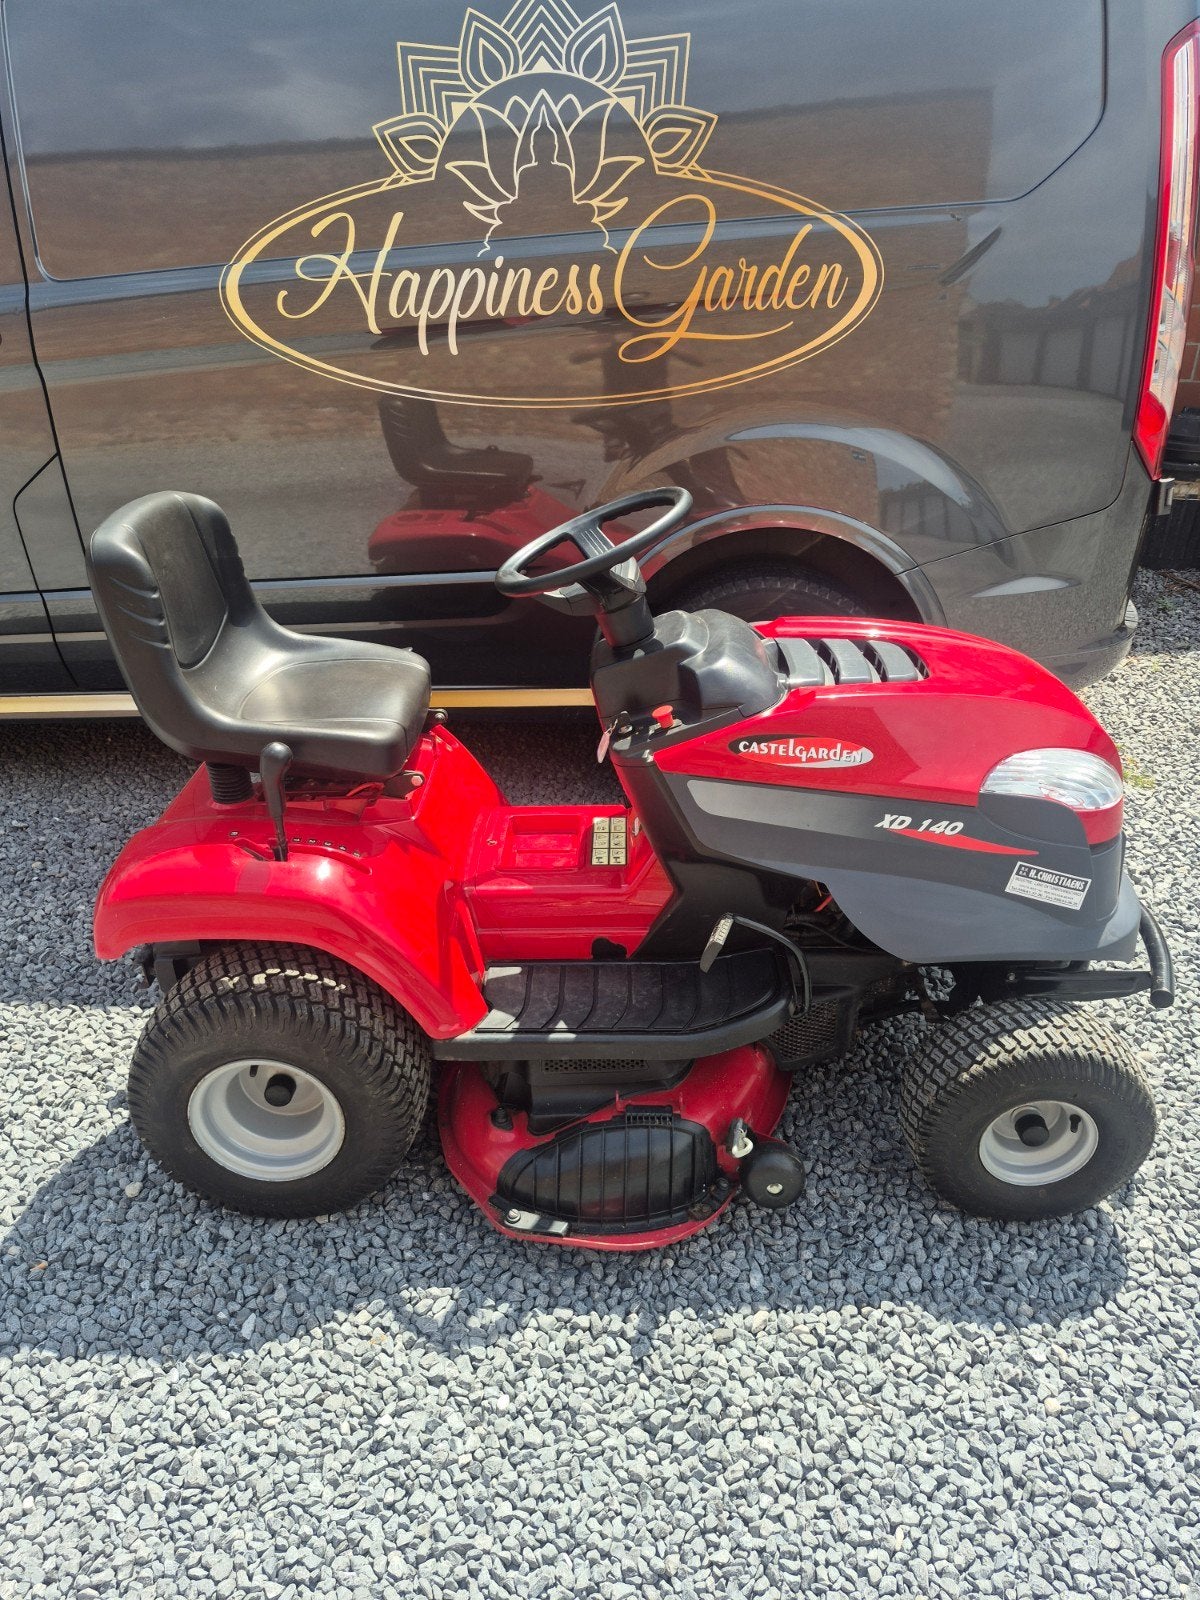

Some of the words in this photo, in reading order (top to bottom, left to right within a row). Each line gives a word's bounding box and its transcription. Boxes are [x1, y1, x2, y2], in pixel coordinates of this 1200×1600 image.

[277, 212, 603, 355] Happiness
[614, 194, 848, 362] Garden
[874, 814, 912, 830] XD
[917, 818, 964, 836] 140
